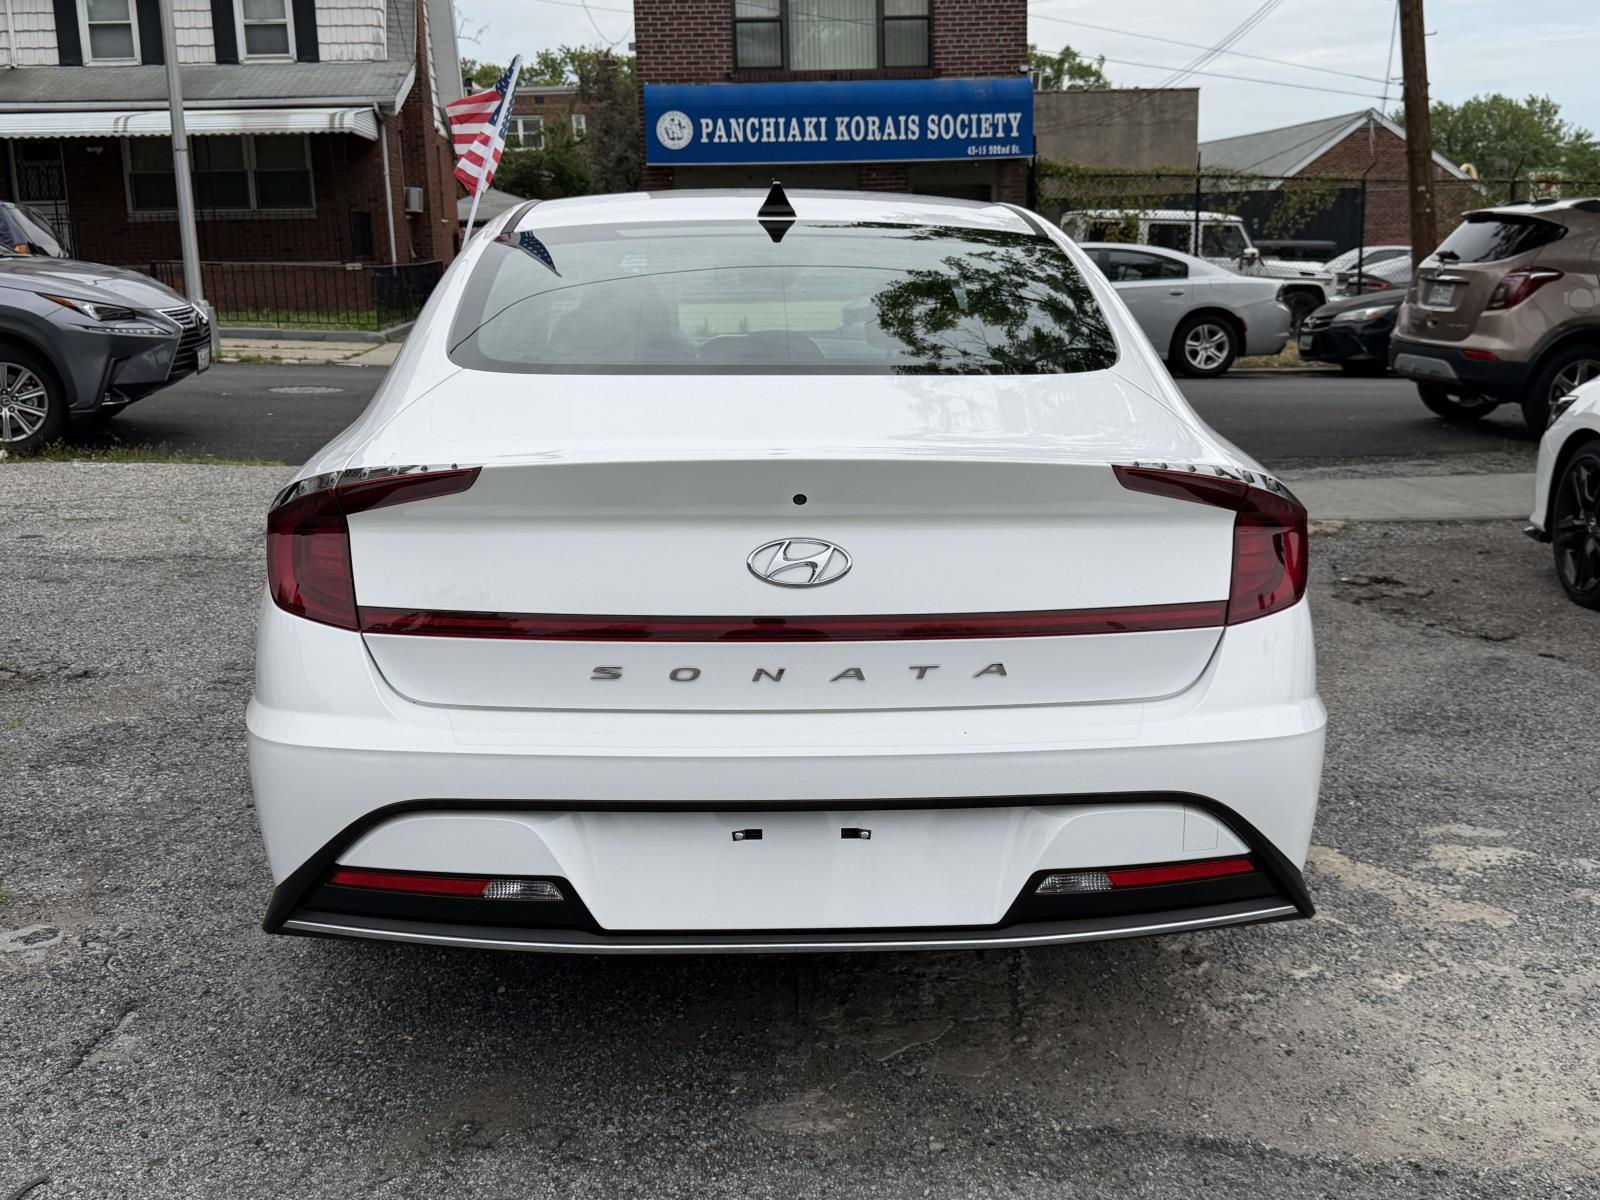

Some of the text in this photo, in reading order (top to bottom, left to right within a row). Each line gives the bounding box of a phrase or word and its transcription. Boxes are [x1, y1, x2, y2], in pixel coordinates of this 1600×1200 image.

[700, 116, 828, 144] PANCHIAKI
[835, 114, 920, 142] KORAIS
[927, 112, 1023, 140] SOCIETY
[590, 663, 1008, 683] SONATA
